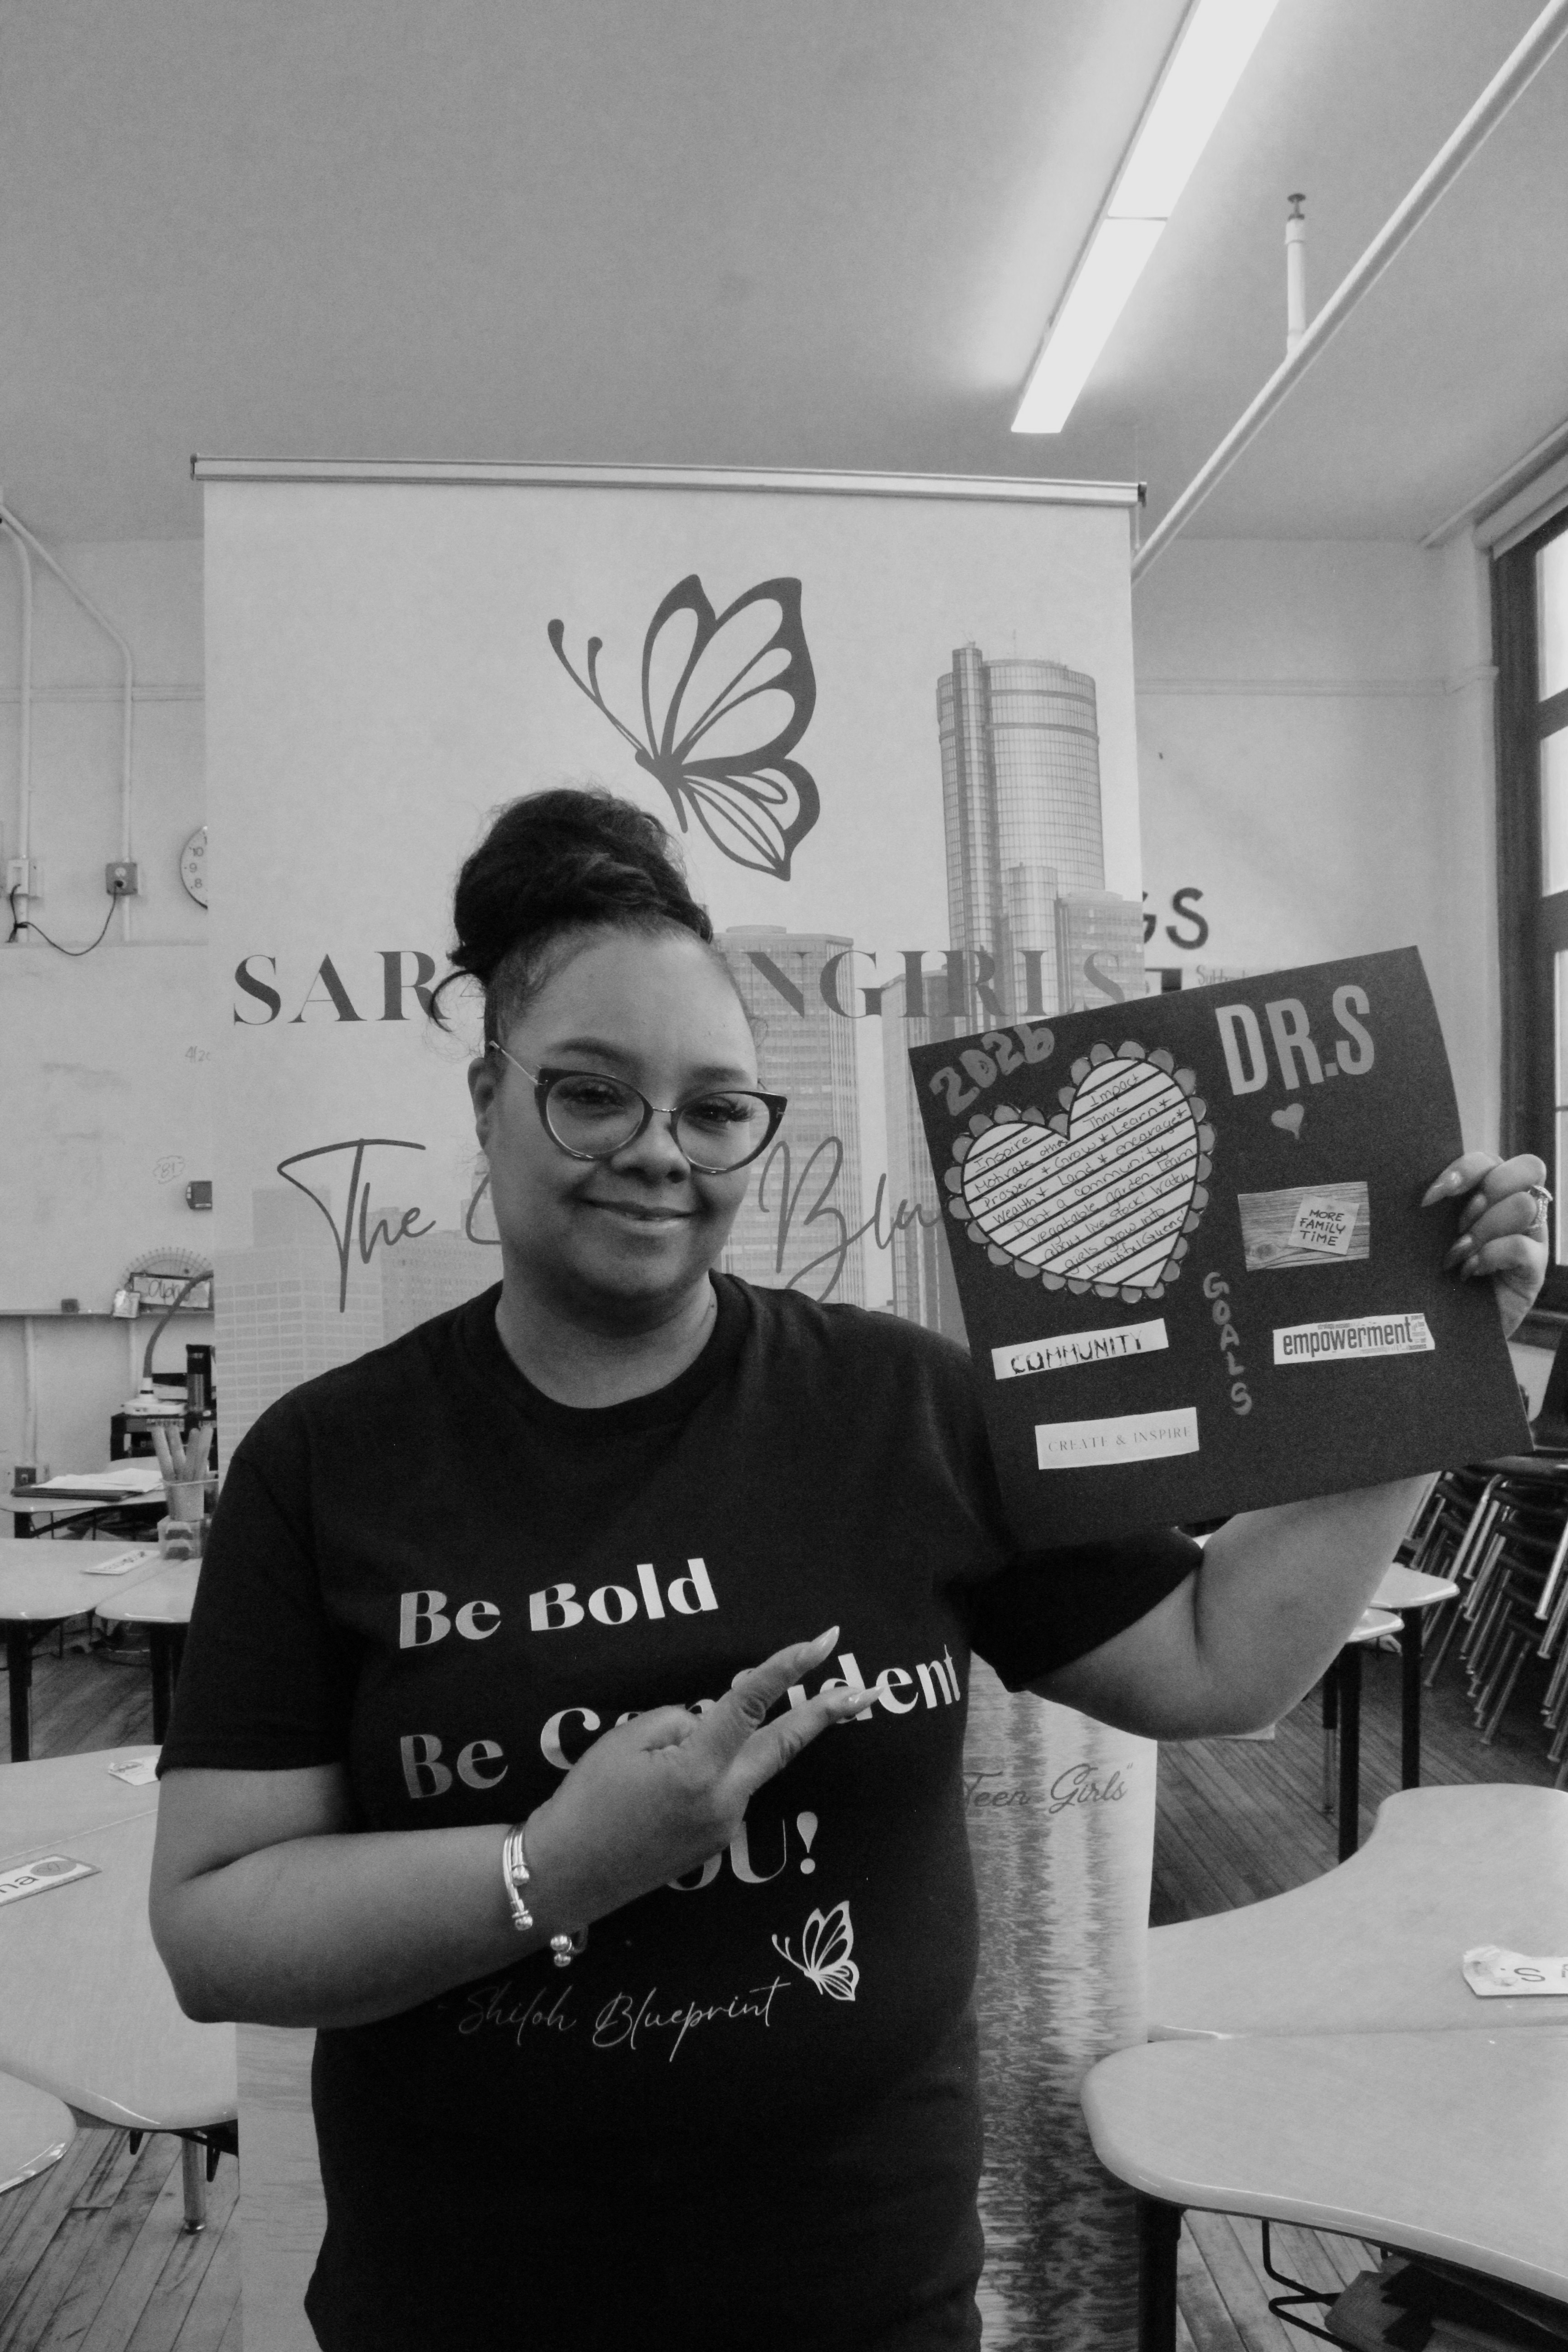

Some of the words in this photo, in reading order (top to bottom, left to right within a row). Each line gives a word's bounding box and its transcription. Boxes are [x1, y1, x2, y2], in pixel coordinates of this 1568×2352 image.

[195, 878, 202, 889] 8
[1215, 985, 1376, 1096] DR.S
[1089, 1074, 1139, 1107] Impact
[1083, 1105, 1127, 1129] Thrive
[974, 1136, 1033, 1173] Inspire
[975, 1158, 1033, 1193] Motivate
[983, 1177, 1033, 1210] Prosper
[1054, 1141, 1097, 1169] Grow
[1112, 1107, 1158, 1136] Learn
[993, 1198, 1037, 1225] Wealth
[1058, 1165, 1094, 1186] Land
[1008, 1209, 1051, 1234] Plant
[1056, 1198, 1068, 1209] a
[1074, 1145, 1166, 1196] community
[277, 1138, 436, 1313] The
[758, 1136, 943, 1303] Blu
[1044, 1235, 1082, 1262] about
[1151, 1173, 1191, 1196] Watch
[1104, 1222, 1137, 1252] grow
[1141, 1207, 1165, 1226] into
[1309, 1209, 1345, 1221] MORE
[1087, 1240, 1139, 1274] beautiful
[1010, 1329, 1142, 1375] COMMUNITY
[1203, 1271, 1253, 1415] GOALS
[1283, 1316, 1413, 1357] empowerment
[1048, 1436, 1108, 1452] CREATE
[1116, 1433, 1127, 1446] &
[1133, 1425, 1192, 1442] INSPIRE
[399, 1589, 501, 1649] Be
[528, 1557, 719, 1631] Bold
[400, 1733, 509, 1799] Be
[962, 1770, 1032, 1811] Teen
[593, 1975, 791, 2062] Blueprint
